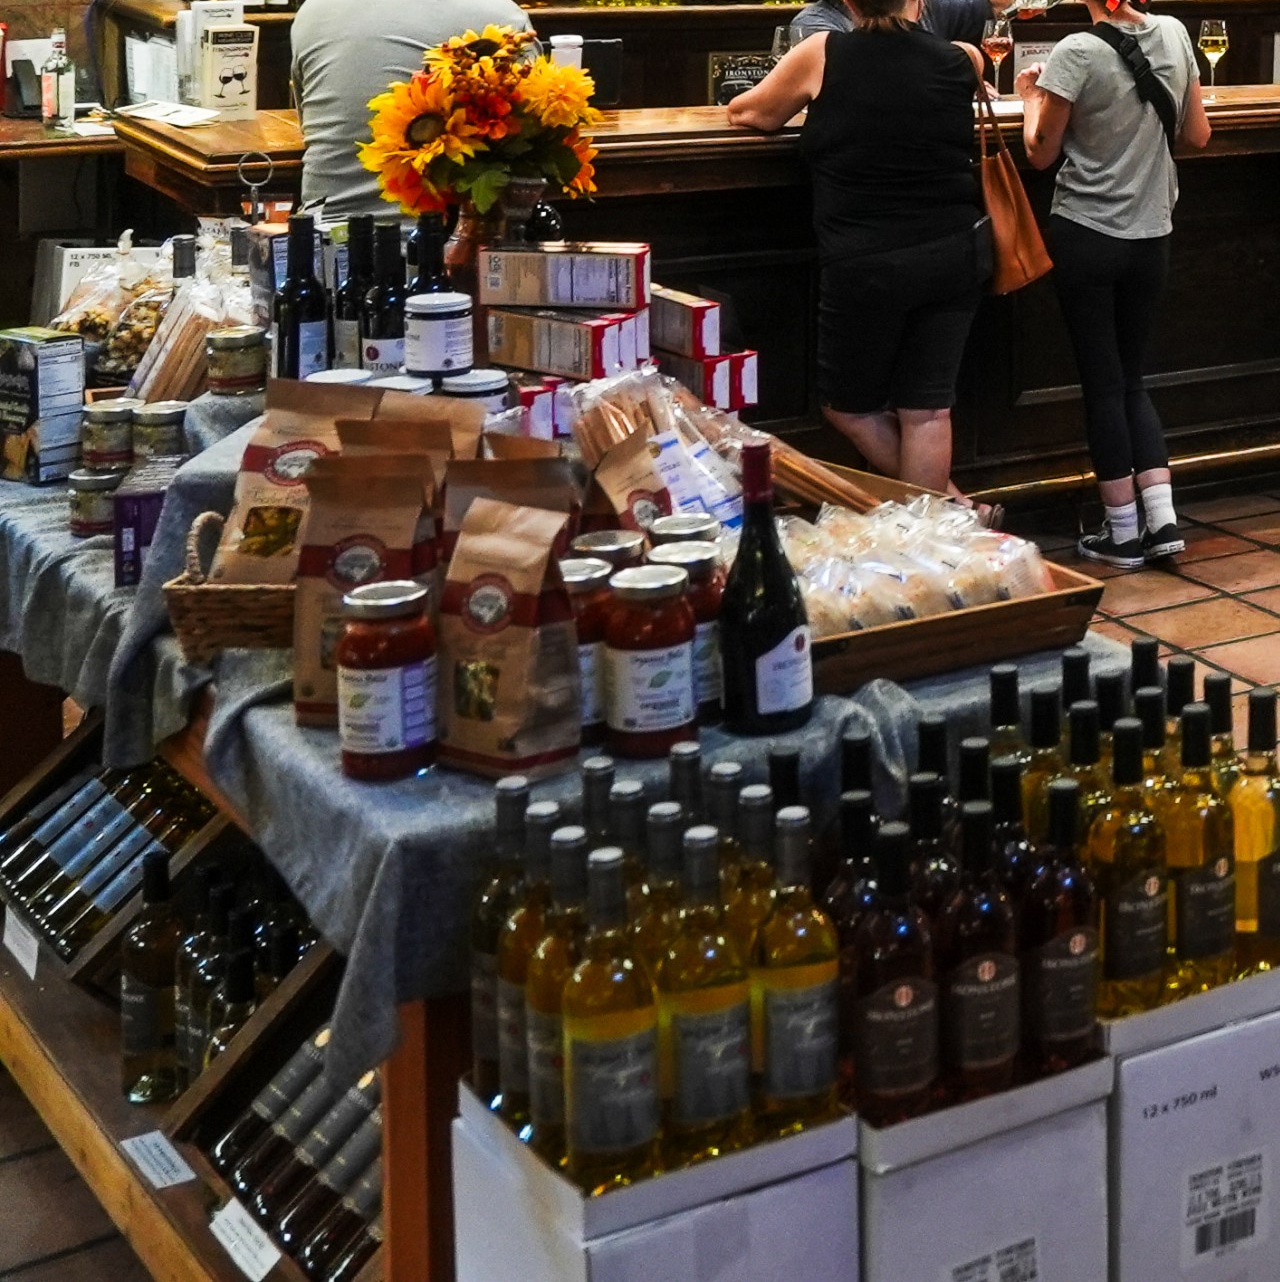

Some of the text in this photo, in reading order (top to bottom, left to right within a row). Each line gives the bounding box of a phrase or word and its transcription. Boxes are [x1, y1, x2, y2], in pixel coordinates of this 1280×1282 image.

[725, 69, 770, 77] IRONSTON
[1142, 1104, 1159, 1119] 12
[1173, 1091, 1198, 1110] 750
